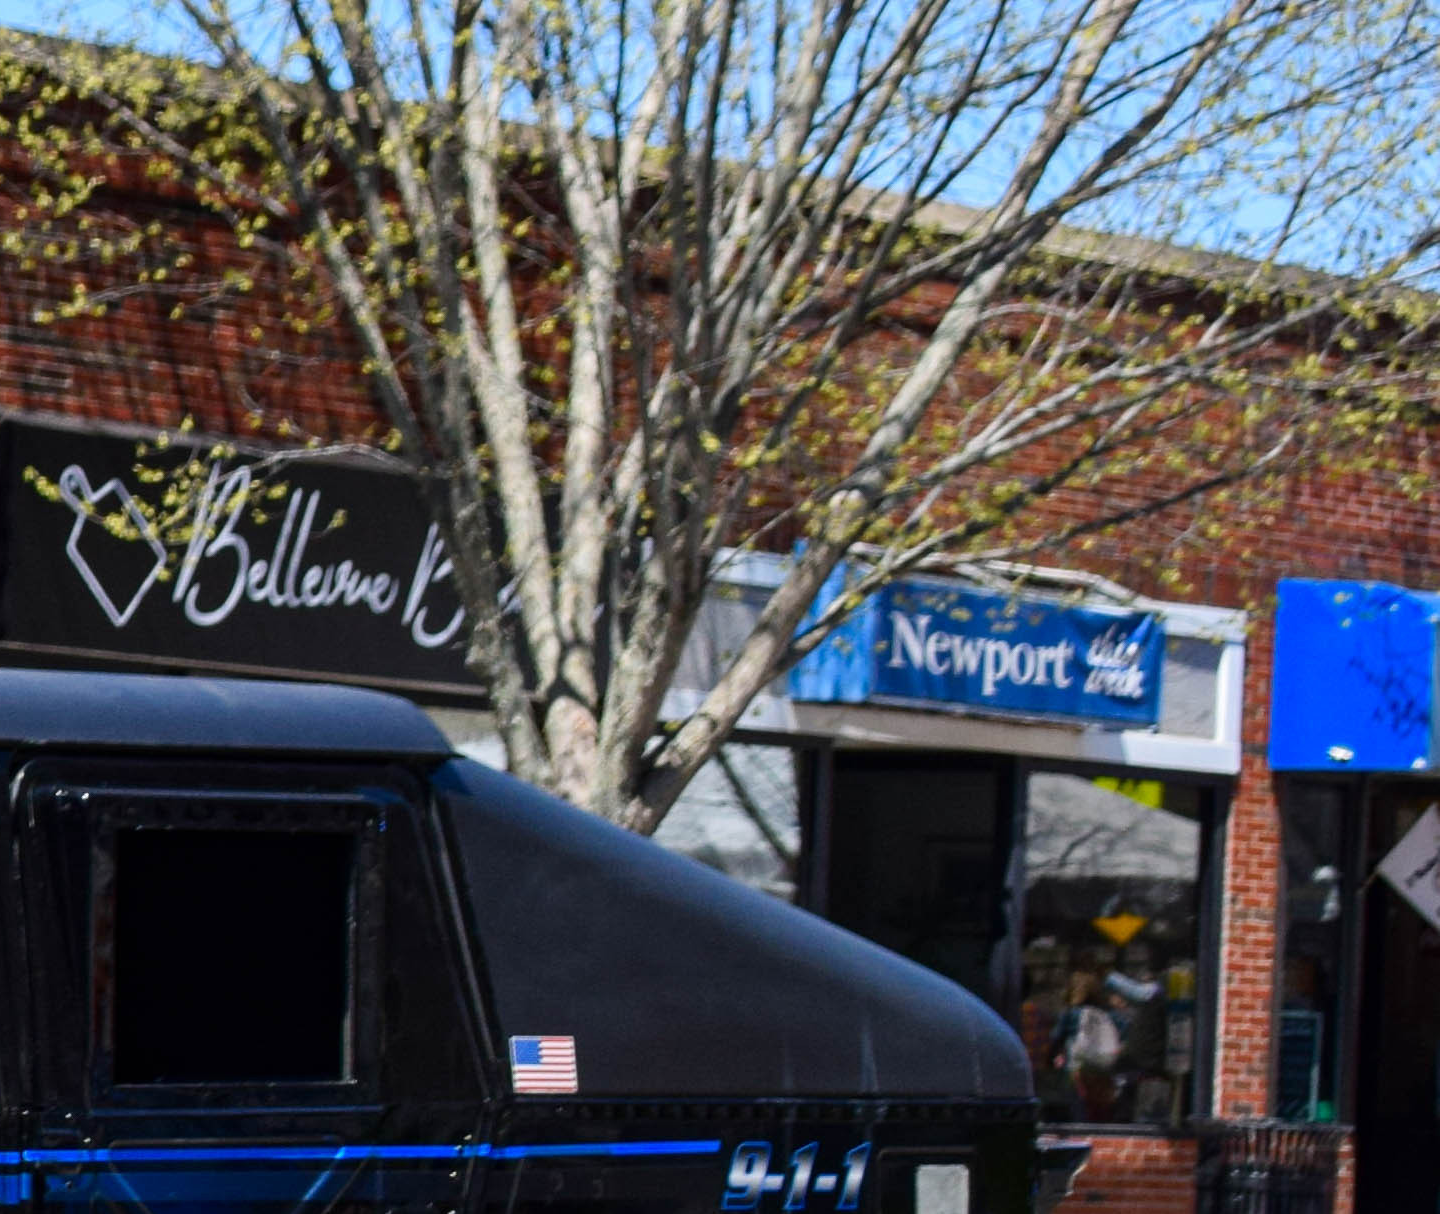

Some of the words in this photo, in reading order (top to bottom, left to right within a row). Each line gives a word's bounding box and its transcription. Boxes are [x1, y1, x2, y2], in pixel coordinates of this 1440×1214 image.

[173, 461, 399, 627] Bellevue
[887, 610, 1074, 697] Newport
[721, 1140, 872, 1212] 9-1-1
